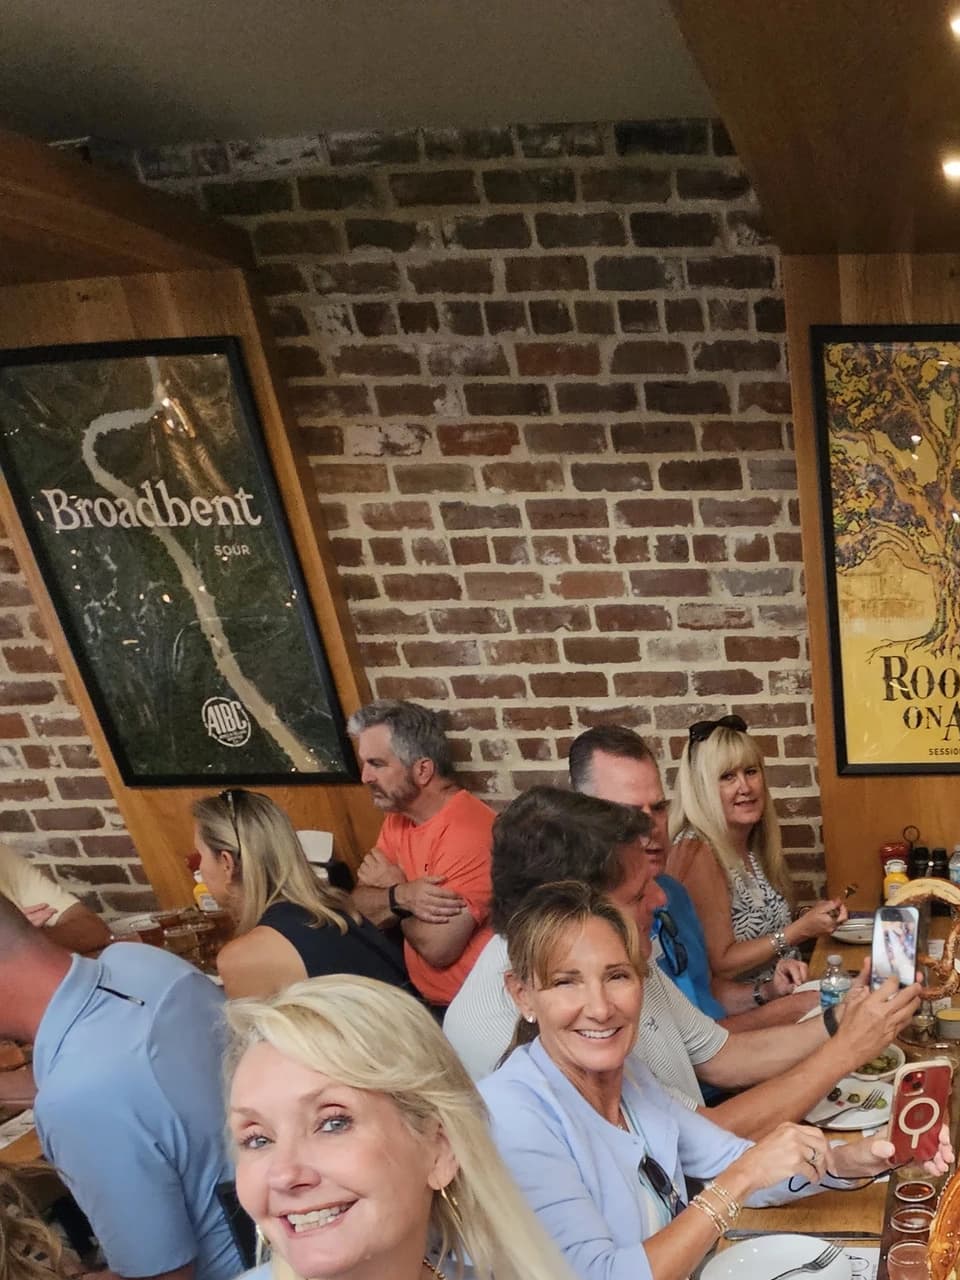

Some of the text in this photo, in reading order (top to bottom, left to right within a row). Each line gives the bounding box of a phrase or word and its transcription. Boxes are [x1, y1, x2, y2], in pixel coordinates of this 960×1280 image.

[41, 480, 262, 530] Broadbent
[214, 544, 250, 556] SOUR
[207, 701, 248, 737] AIBC
[902, 705, 943, 730] ON
